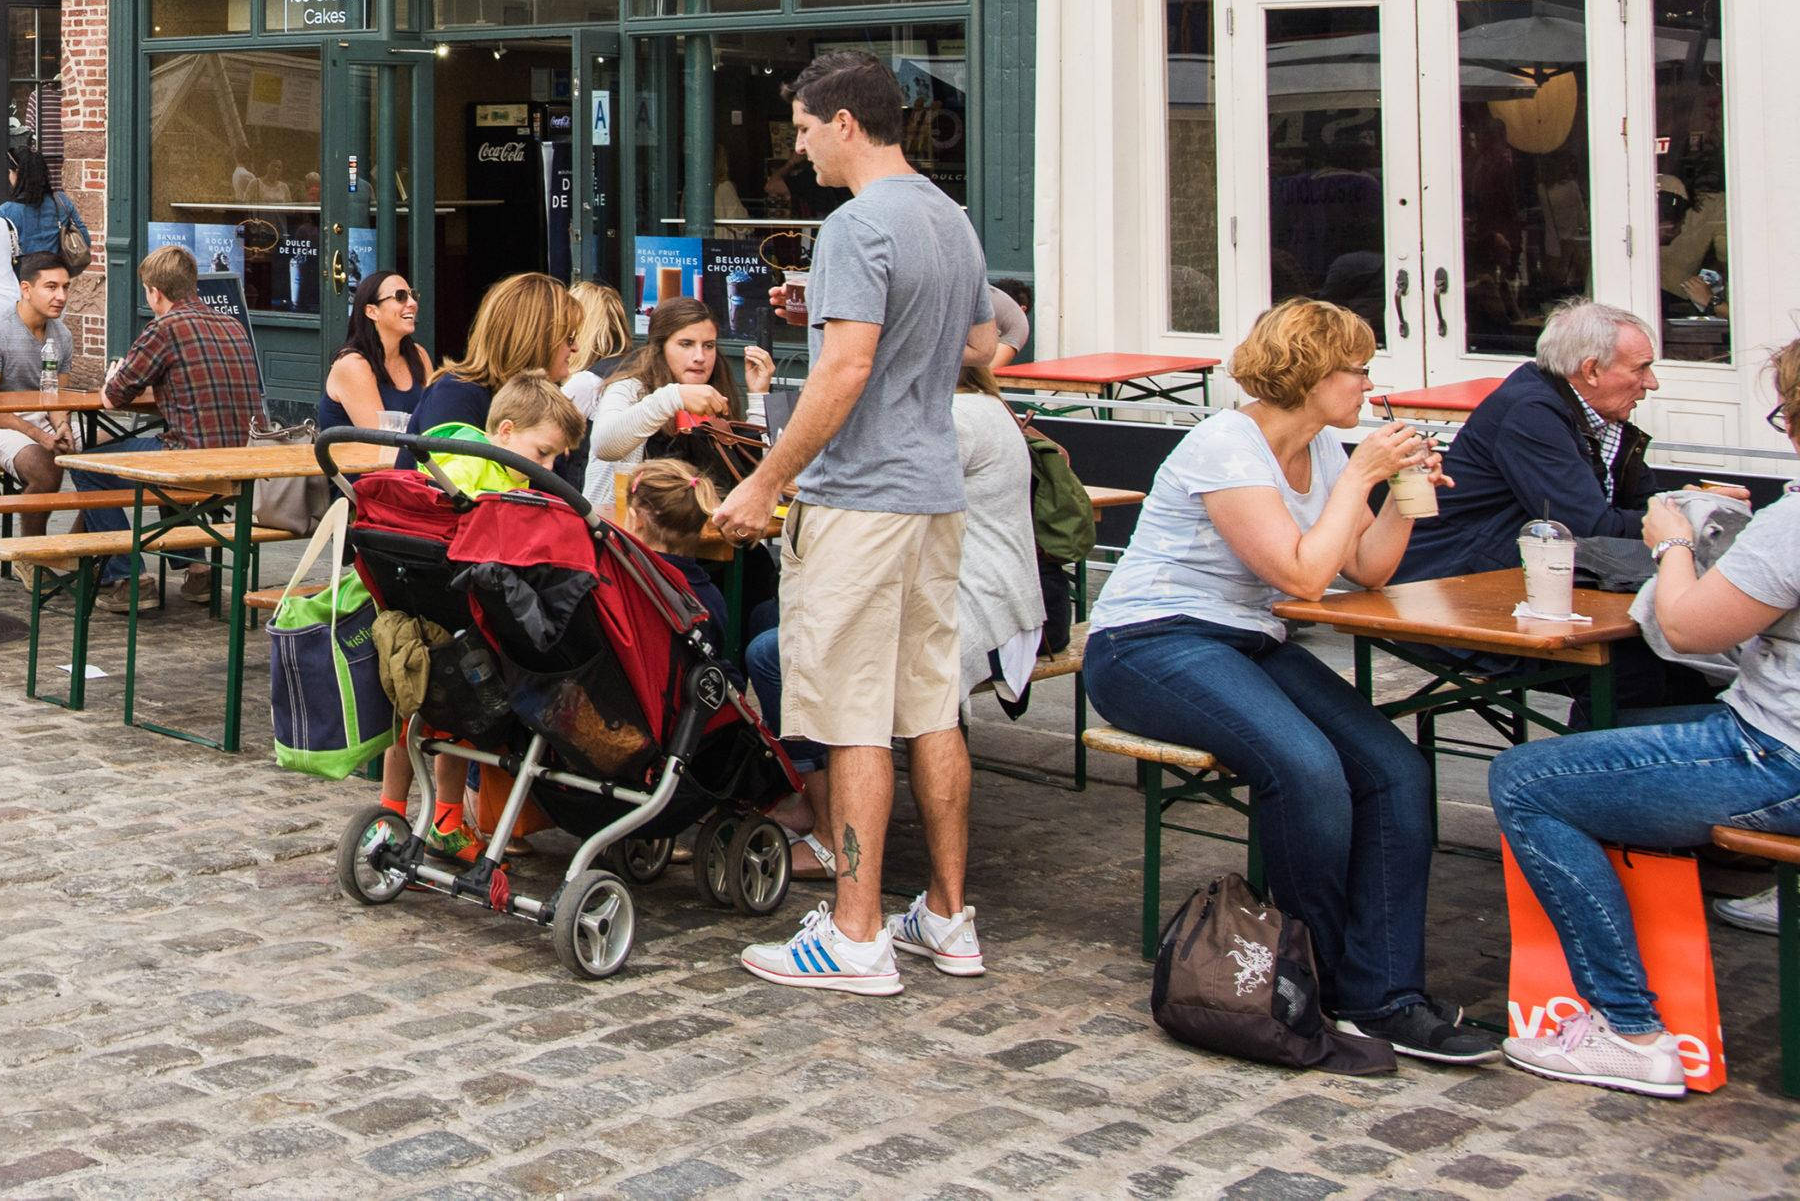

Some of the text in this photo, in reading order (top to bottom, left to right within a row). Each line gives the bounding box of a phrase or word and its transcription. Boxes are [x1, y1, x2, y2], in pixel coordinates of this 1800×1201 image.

[303, 7, 346, 25] Cakes
[594, 100, 607, 129] A
[478, 141, 526, 162] Coca-Cola
[206, 237, 234, 246] ROCKY
[285, 239, 311, 248] DULCE
[279, 247, 318, 256] DE LECHE
[658, 249, 680, 257] FRUIT
[640, 256, 699, 266] SMOOTHIES
[715, 256, 759, 265] BELGIAN
[213, 305, 240, 315] ECHE
